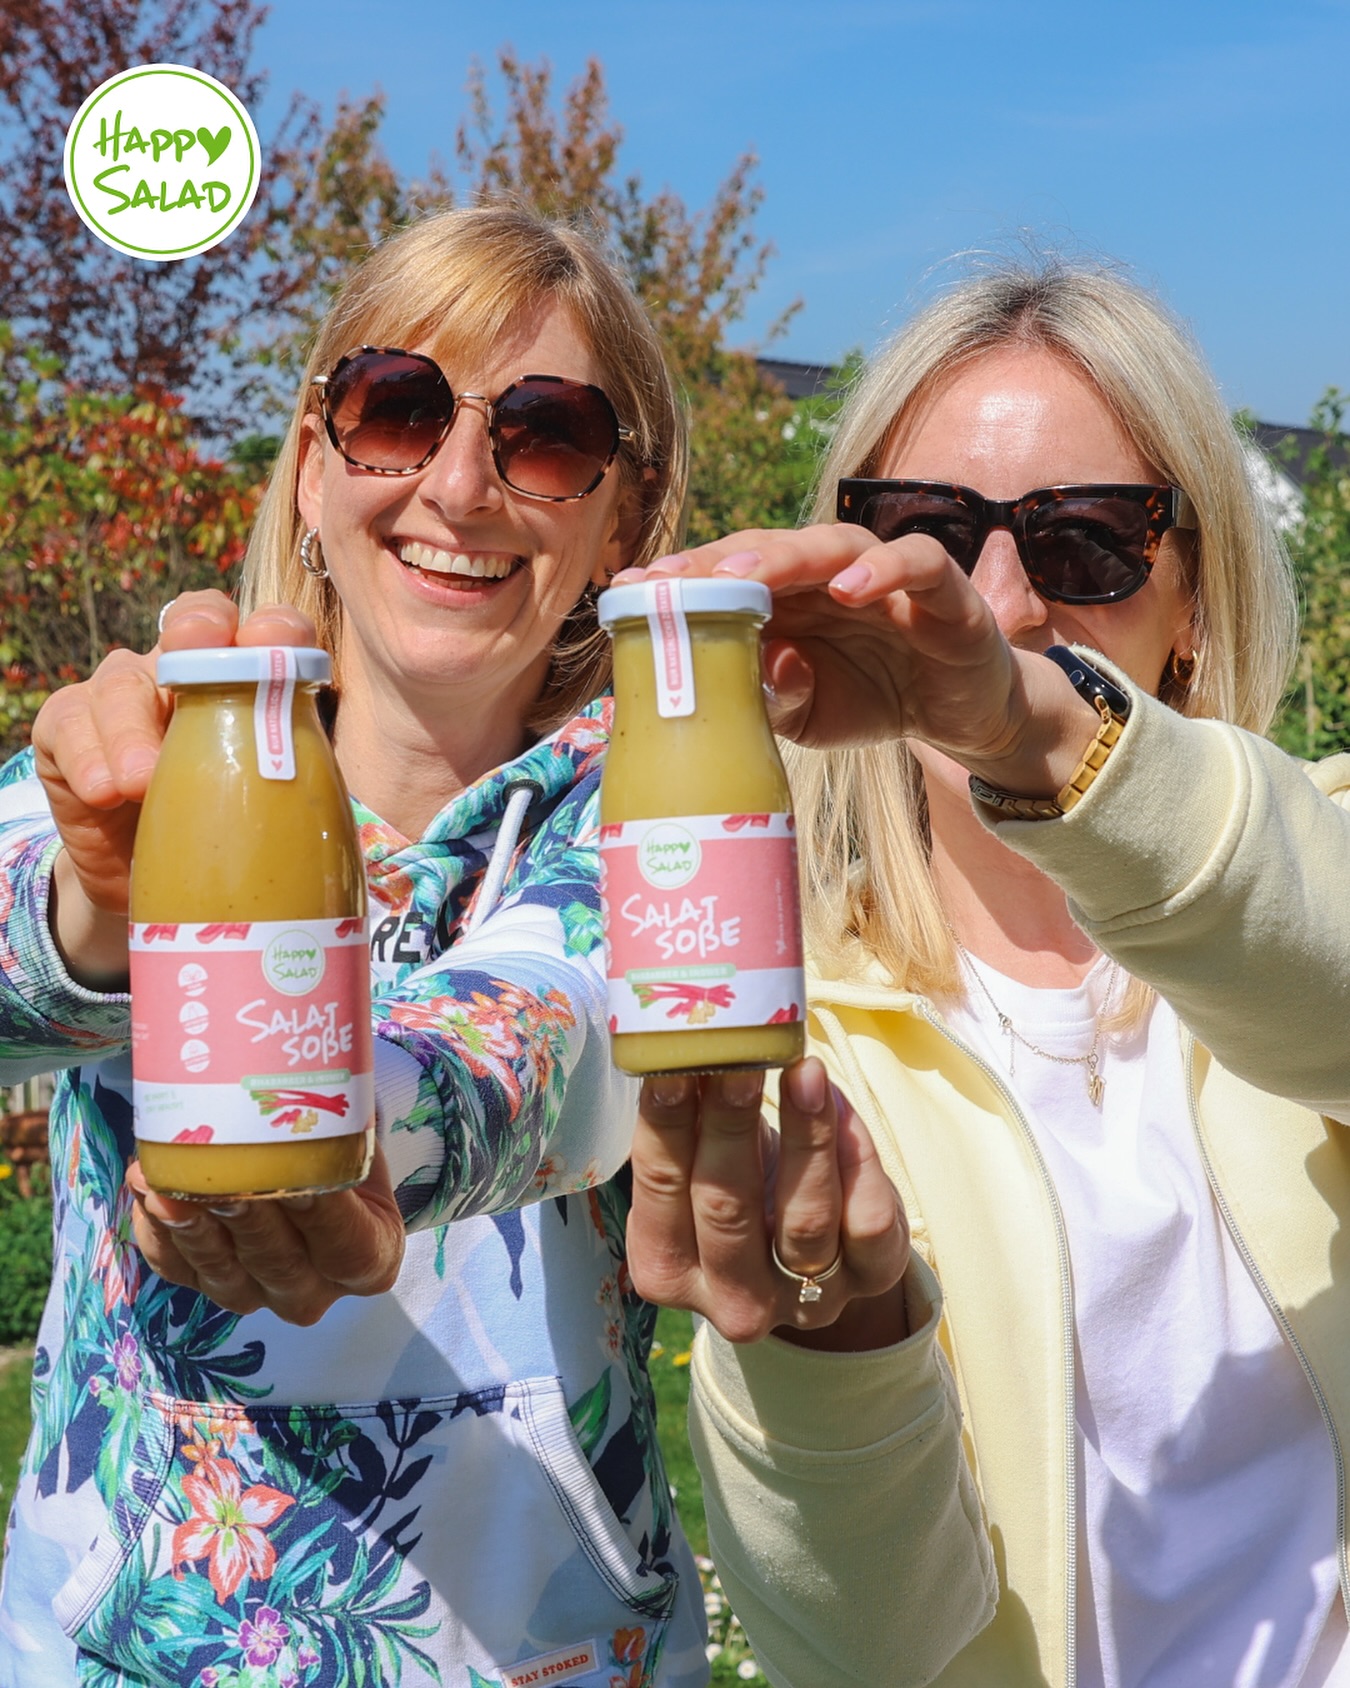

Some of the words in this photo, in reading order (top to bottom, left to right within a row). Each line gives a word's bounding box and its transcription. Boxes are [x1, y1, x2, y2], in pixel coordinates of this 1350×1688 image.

[646, 857, 692, 874] SALAD
[620, 893, 719, 937] SALAT
[272, 963, 318, 980] SALAD
[235, 999, 339, 1043] SALAT
[511, 1670, 540, 1686] STAY
[542, 1654, 589, 1676] STOKED
